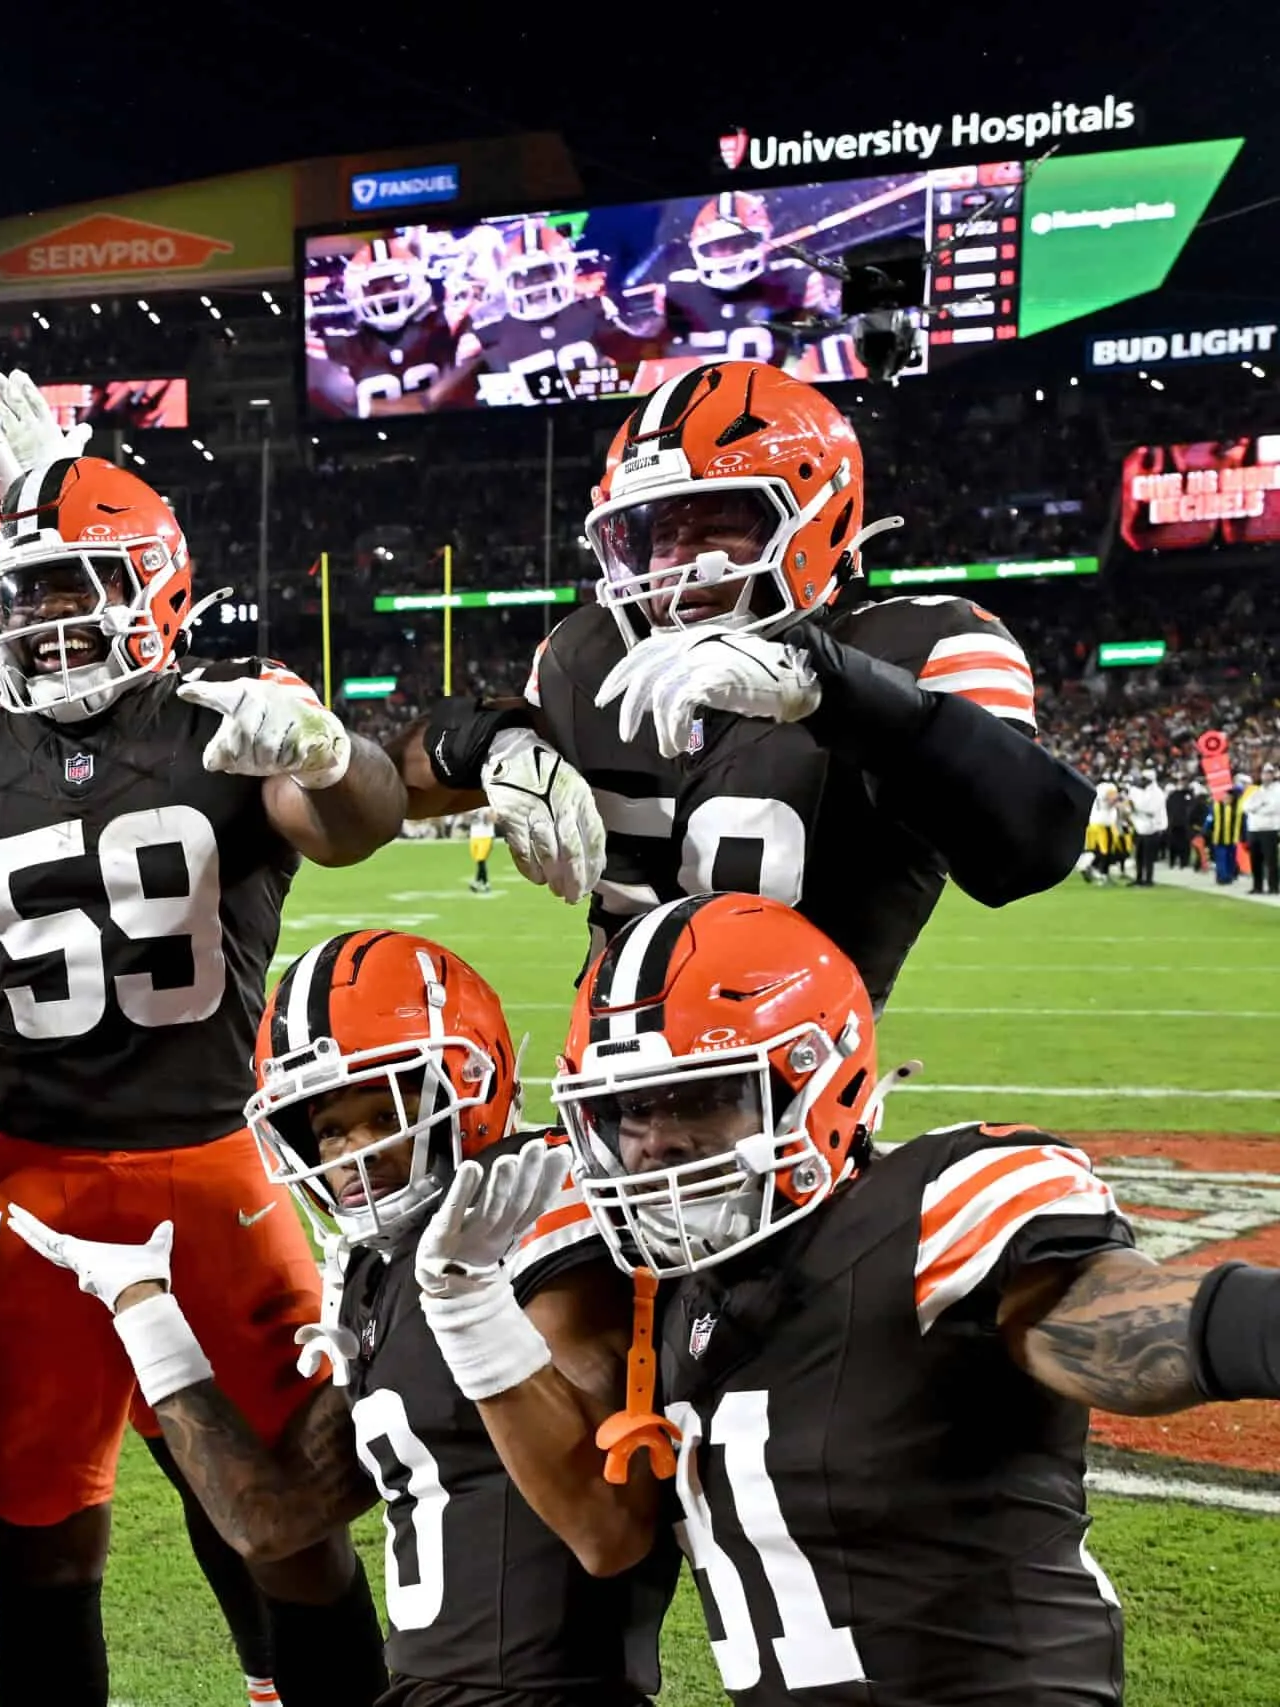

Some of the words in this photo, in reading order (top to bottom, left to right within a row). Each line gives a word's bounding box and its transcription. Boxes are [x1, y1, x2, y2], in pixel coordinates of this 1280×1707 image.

[750, 119, 942, 170] University
[952, 94, 1136, 147] Hospitals
[378, 175, 458, 198] FANDUEL
[27, 237, 176, 272] SERVPRO
[1092, 335, 1168, 366] BUD
[1171, 325, 1277, 359] LIGHT
[707, 464, 752, 477] OAKLEY
